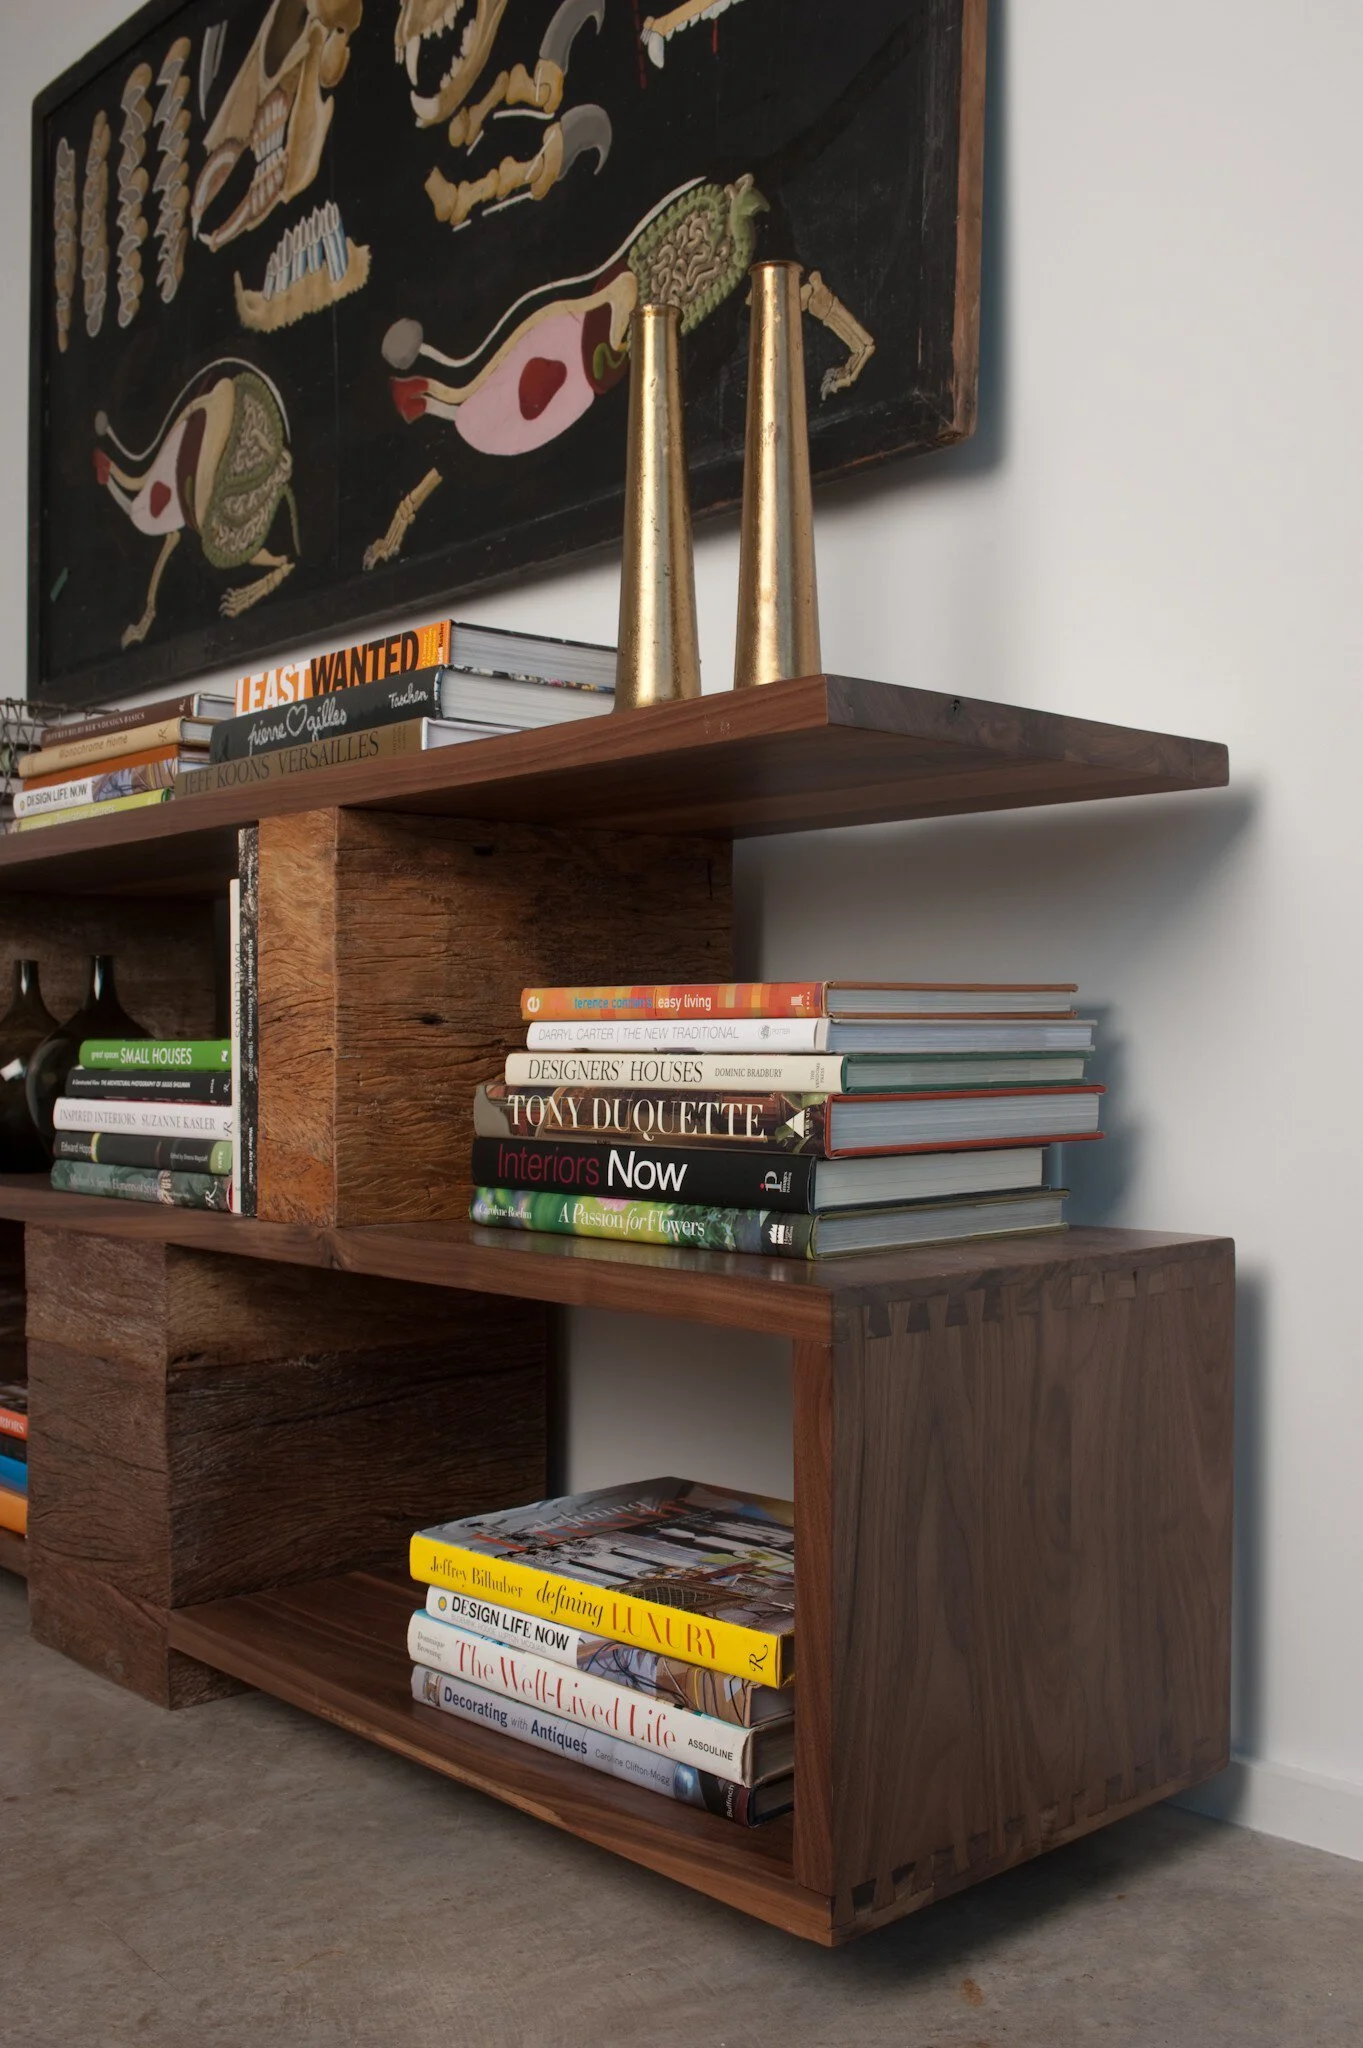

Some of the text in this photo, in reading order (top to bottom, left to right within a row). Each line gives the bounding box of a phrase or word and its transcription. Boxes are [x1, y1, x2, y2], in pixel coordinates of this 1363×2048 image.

[236, 659, 312, 717] LEAST
[311, 630, 419, 697] WANTED
[389, 682, 429, 710] Taschen
[247, 721, 288, 756] pierre
[306, 697, 347, 742] gilles
[107, 735, 128, 747] Home
[183, 770, 213, 795] JEFF
[216, 755, 270, 788] KOONS
[278, 731, 380, 775] VERSAILLES
[26, 783, 89, 807] DESIGN LIFE NOW
[574, 996, 609, 1009] terence
[657, 996, 682, 1013] easy
[683, 992, 712, 1011] living
[538, 1026, 740, 1041] DARRYL CARTER THE NEW TRADITIONAL
[120, 1047, 150, 1064] SMALL
[152, 1047, 193, 1065] HOUSES
[528, 1058, 703, 1082] DESIGNERS' HOUSES
[714, 1067, 783, 1078] DOMINIC BRADBURY
[60, 1109, 216, 1131] INSPIRED INTERIORS SUZANNE KASLER
[508, 1094, 765, 1142] TONY DUQUETTE
[61, 1141, 79, 1153] Edward
[498, 1142, 688, 1192] Interiors Now
[478, 1203, 532, 1220] Carolyne Roehm
[558, 1202, 705, 1238] A Passion for Flowers
[430, 1555, 720, 1660] Jeffrey Bilhuber defining LUXURY
[451, 1596, 570, 1651] DESIGN LIFE NOW
[417, 1630, 446, 1649] Dominique
[455, 1639, 677, 1751] The Well-Lived Life
[444, 1686, 588, 1755] Decorating with Antiques
[687, 1737, 734, 1761] ASSOULINE
[595, 1748, 671, 1786] Caroline Clifton-Mogg
[726, 1784, 736, 1818] Bulfinch
